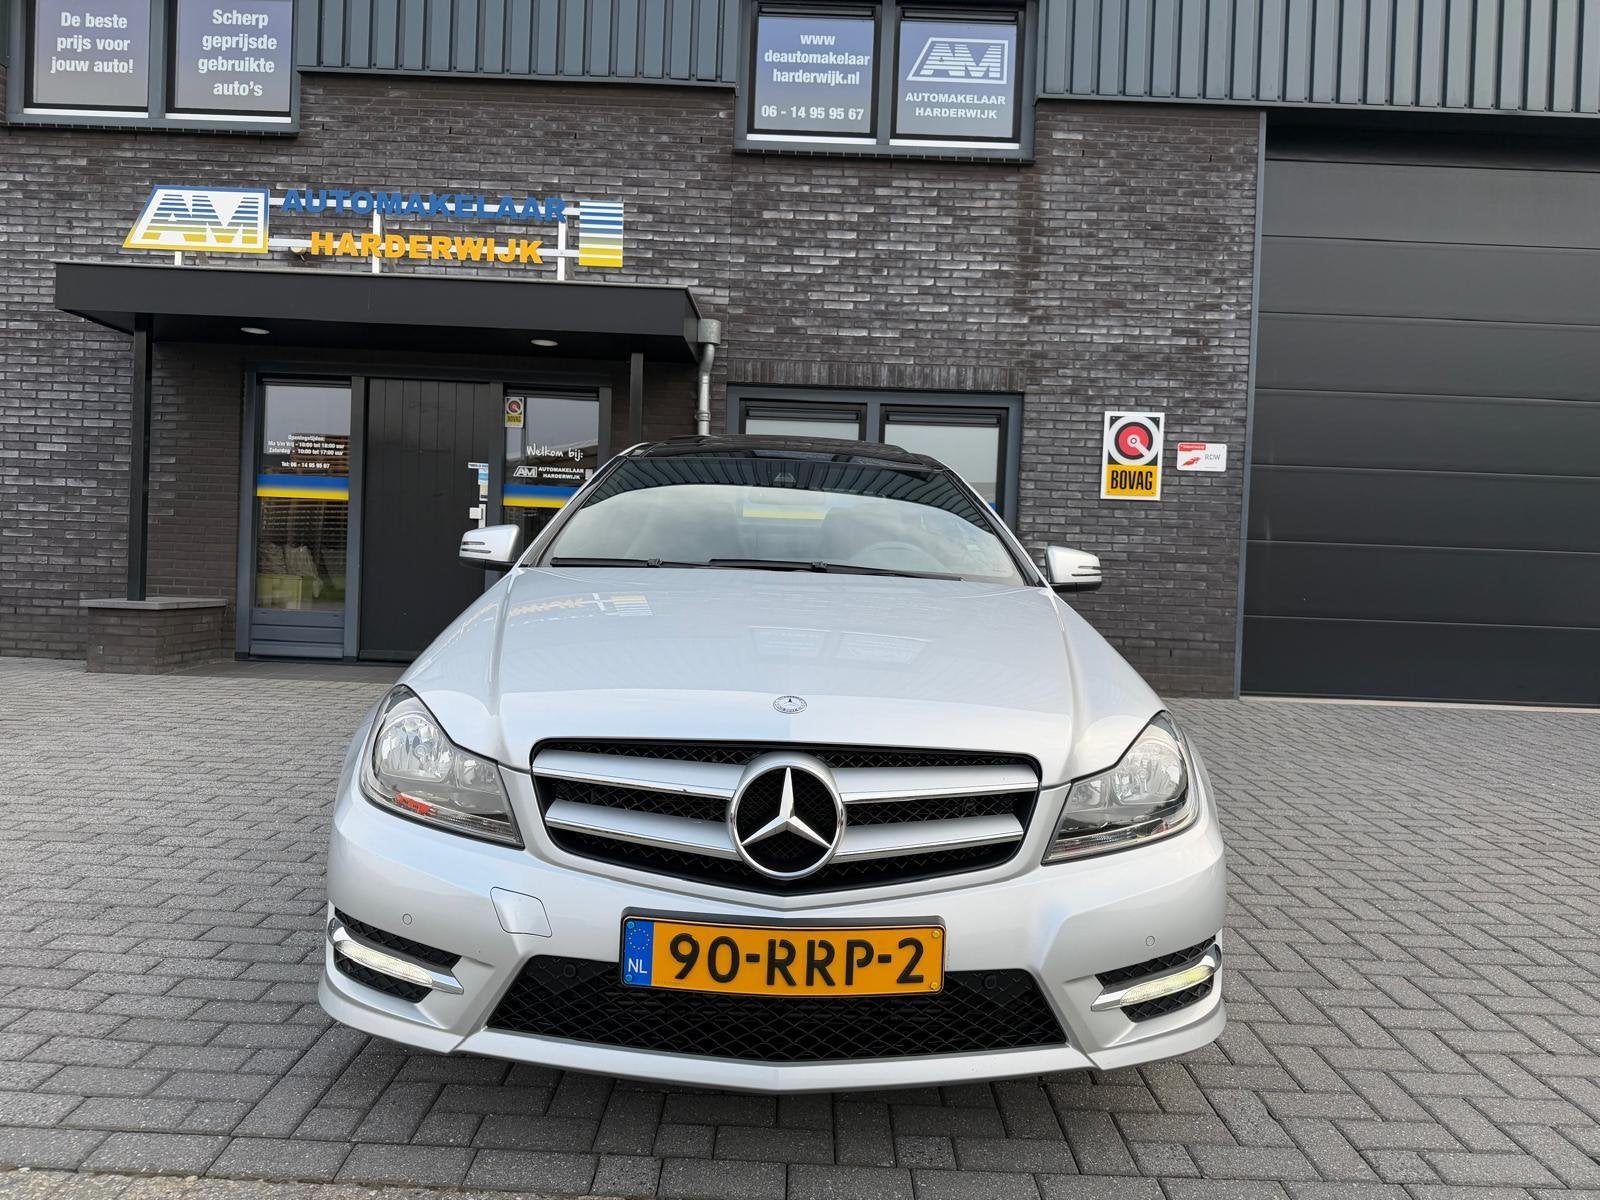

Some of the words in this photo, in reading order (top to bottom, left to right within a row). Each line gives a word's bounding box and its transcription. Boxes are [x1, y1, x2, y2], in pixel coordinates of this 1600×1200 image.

[61, 12, 80, 27] De
[85, 13, 128, 29] beste
[212, 9, 268, 27] Scherp
[57, 35, 91, 52] prijs
[96, 39, 130, 51] voor
[202, 34, 277, 51] geprijsde
[800, 35, 835, 46] www
[50, 57, 89, 73] jouw
[93, 58, 133, 73] auto!
[198, 57, 275, 74] gebruikte
[764, 50, 870, 66] deautomakelaar
[919, 43, 1001, 78] AM
[773, 69, 860, 86] harderwijk.nl
[213, 81, 263, 97] auto's
[905, 92, 1006, 105] AUTOMAKELAAR
[761, 105, 777, 118] 06
[791, 106, 806, 118] 14
[810, 107, 825, 119] 95
[829, 107, 845, 120] 95
[848, 108, 864, 120] 67
[915, 107, 998, 119] HARDERWIJK
[280, 188, 567, 223] AUTOMAKELAAR
[141, 194, 258, 248] AM
[311, 231, 544, 265] HARDERWIJK
[526, 443, 563, 457] Welkom
[569, 448, 584, 462] bij:
[1110, 469, 1153, 491] BOVAG
[627, 957, 648, 975] NL
[669, 933, 924, 987] 90-RRP-2
